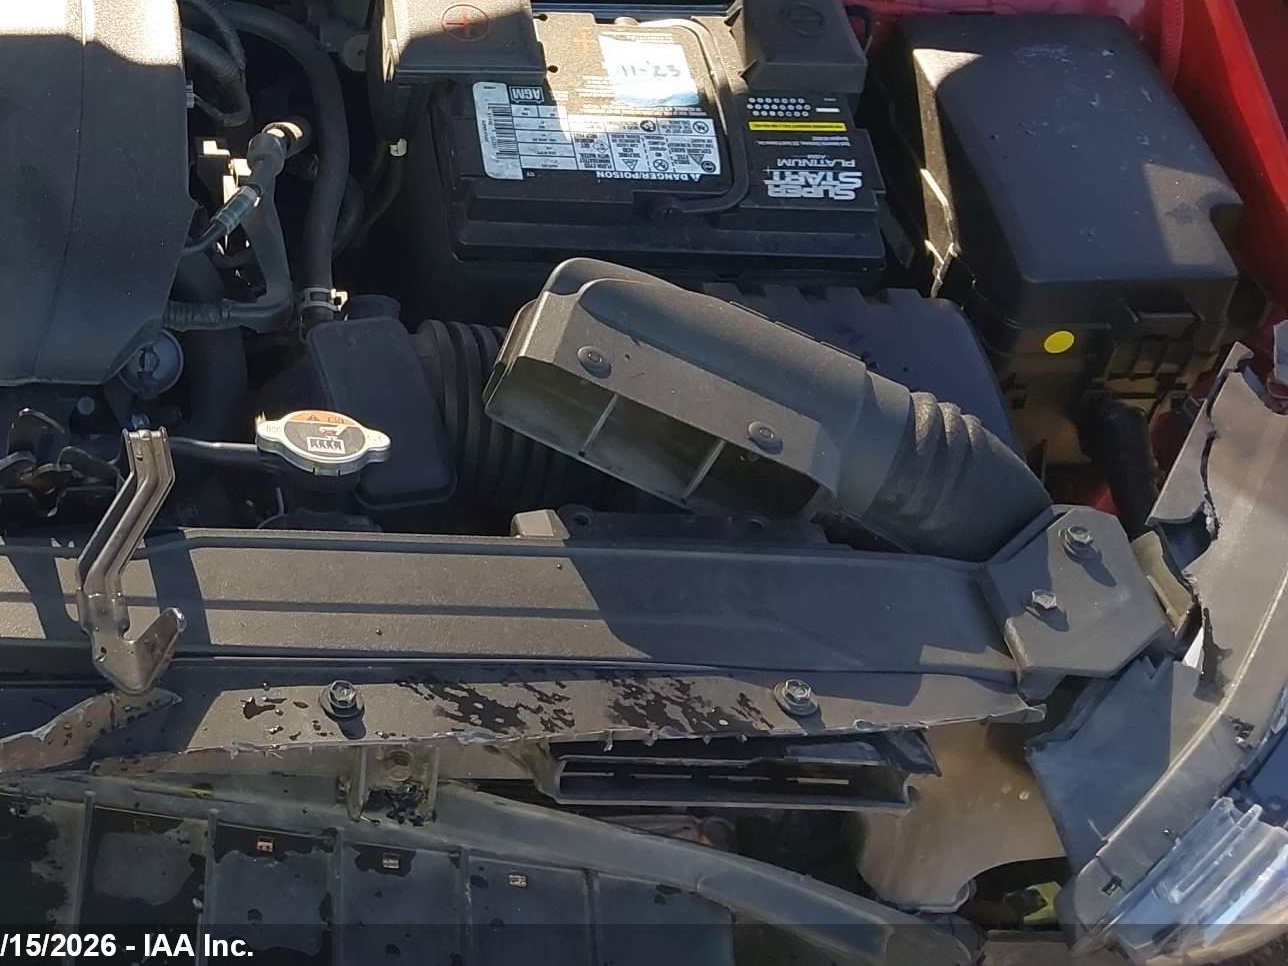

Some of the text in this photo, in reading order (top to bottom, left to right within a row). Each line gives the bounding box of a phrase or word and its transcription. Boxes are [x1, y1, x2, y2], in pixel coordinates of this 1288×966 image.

[512, 87, 541, 101] AGM
[776, 158, 856, 168] PLATINUM
[595, 170, 688, 181] DANGER/POISON
[762, 171, 863, 189] START
[767, 184, 856, 200] SUPER
